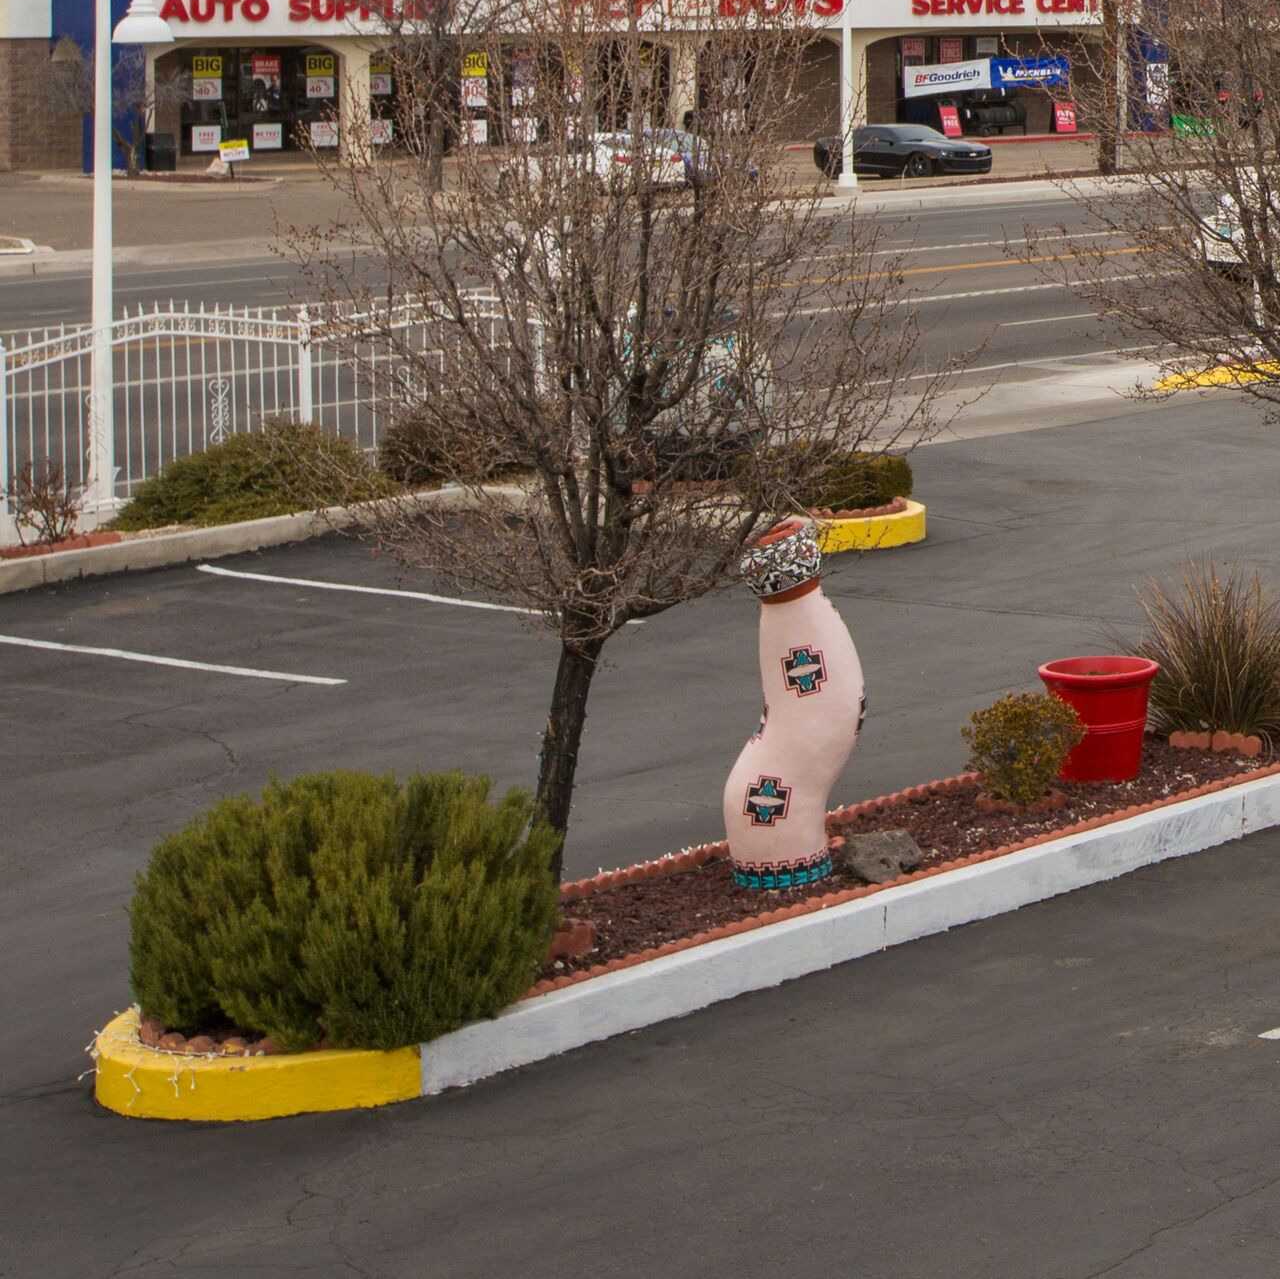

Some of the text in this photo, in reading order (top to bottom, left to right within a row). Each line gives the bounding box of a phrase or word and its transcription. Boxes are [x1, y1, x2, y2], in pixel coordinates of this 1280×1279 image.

[194, 58, 221, 72] BIG
[308, 57, 333, 70] BIG
[914, 69, 980, 84] BFGoodrich
